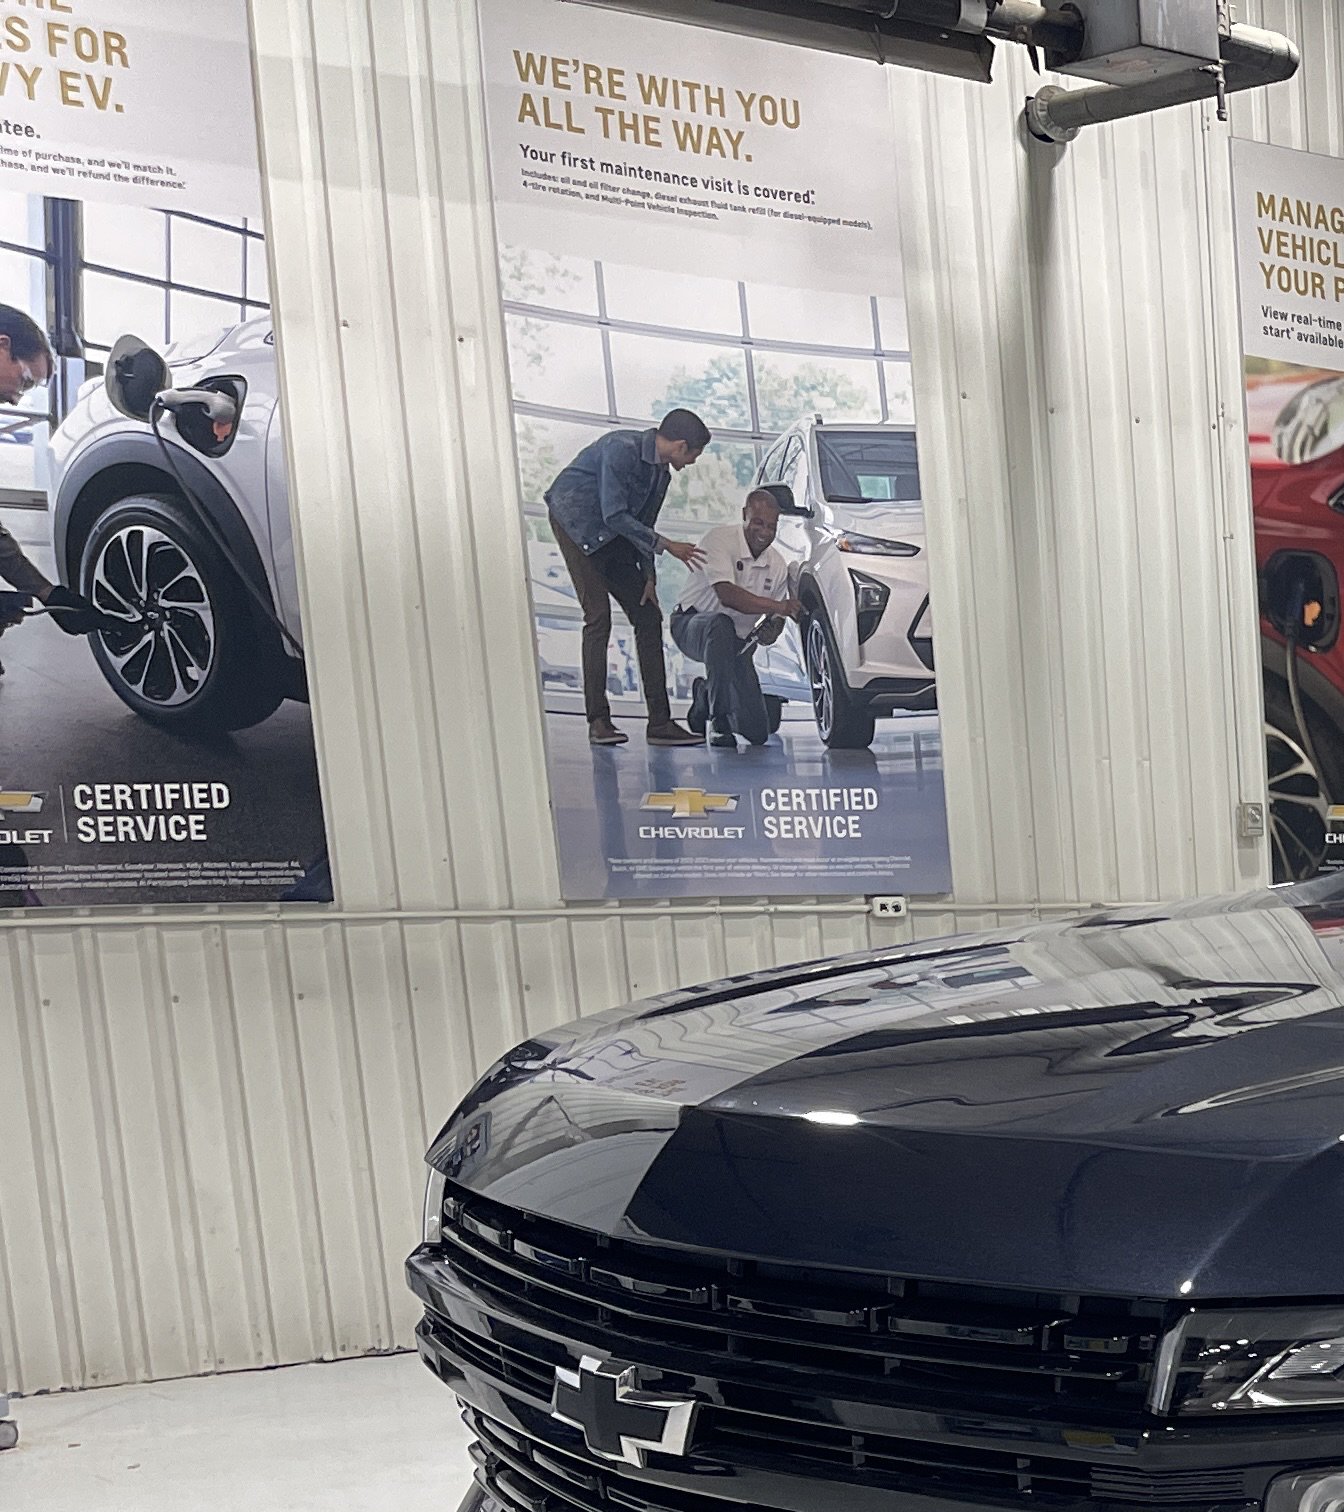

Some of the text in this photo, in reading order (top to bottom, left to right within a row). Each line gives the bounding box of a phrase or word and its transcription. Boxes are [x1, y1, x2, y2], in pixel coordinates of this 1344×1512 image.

[47, 22, 130, 68] FOR
[59, 69, 125, 113] EV.
[512, 49, 800, 129] WE'RE WITH YOU
[518, 93, 753, 162] ALL THE WAY.
[22, 149, 32, 159] of
[35, 151, 85, 166] purchase,
[87, 158, 105, 168] and
[108, 160, 130, 171] we'll
[133, 163, 164, 174] match
[30, 164, 49, 174] and
[51, 167, 75, 177] we'll
[78, 169, 111, 181] refund
[113, 174, 130, 184] the
[519, 143, 556, 163] Your
[561, 151, 597, 171] first
[600, 162, 698, 188] maintenance
[701, 176, 733, 194] visit
[738, 180, 750, 196] is
[1259, 261, 1326, 301] YOUR
[1261, 304, 1288, 322] View
[1291, 313, 1343, 332] real-time
[1297, 331, 1344, 349] available
[72, 782, 231, 811] CERTIFIED
[760, 788, 879, 811] CERTIFIED
[77, 814, 208, 842] SERVICE
[639, 826, 746, 839] CHEVROLET
[763, 815, 862, 839] SERVICE
